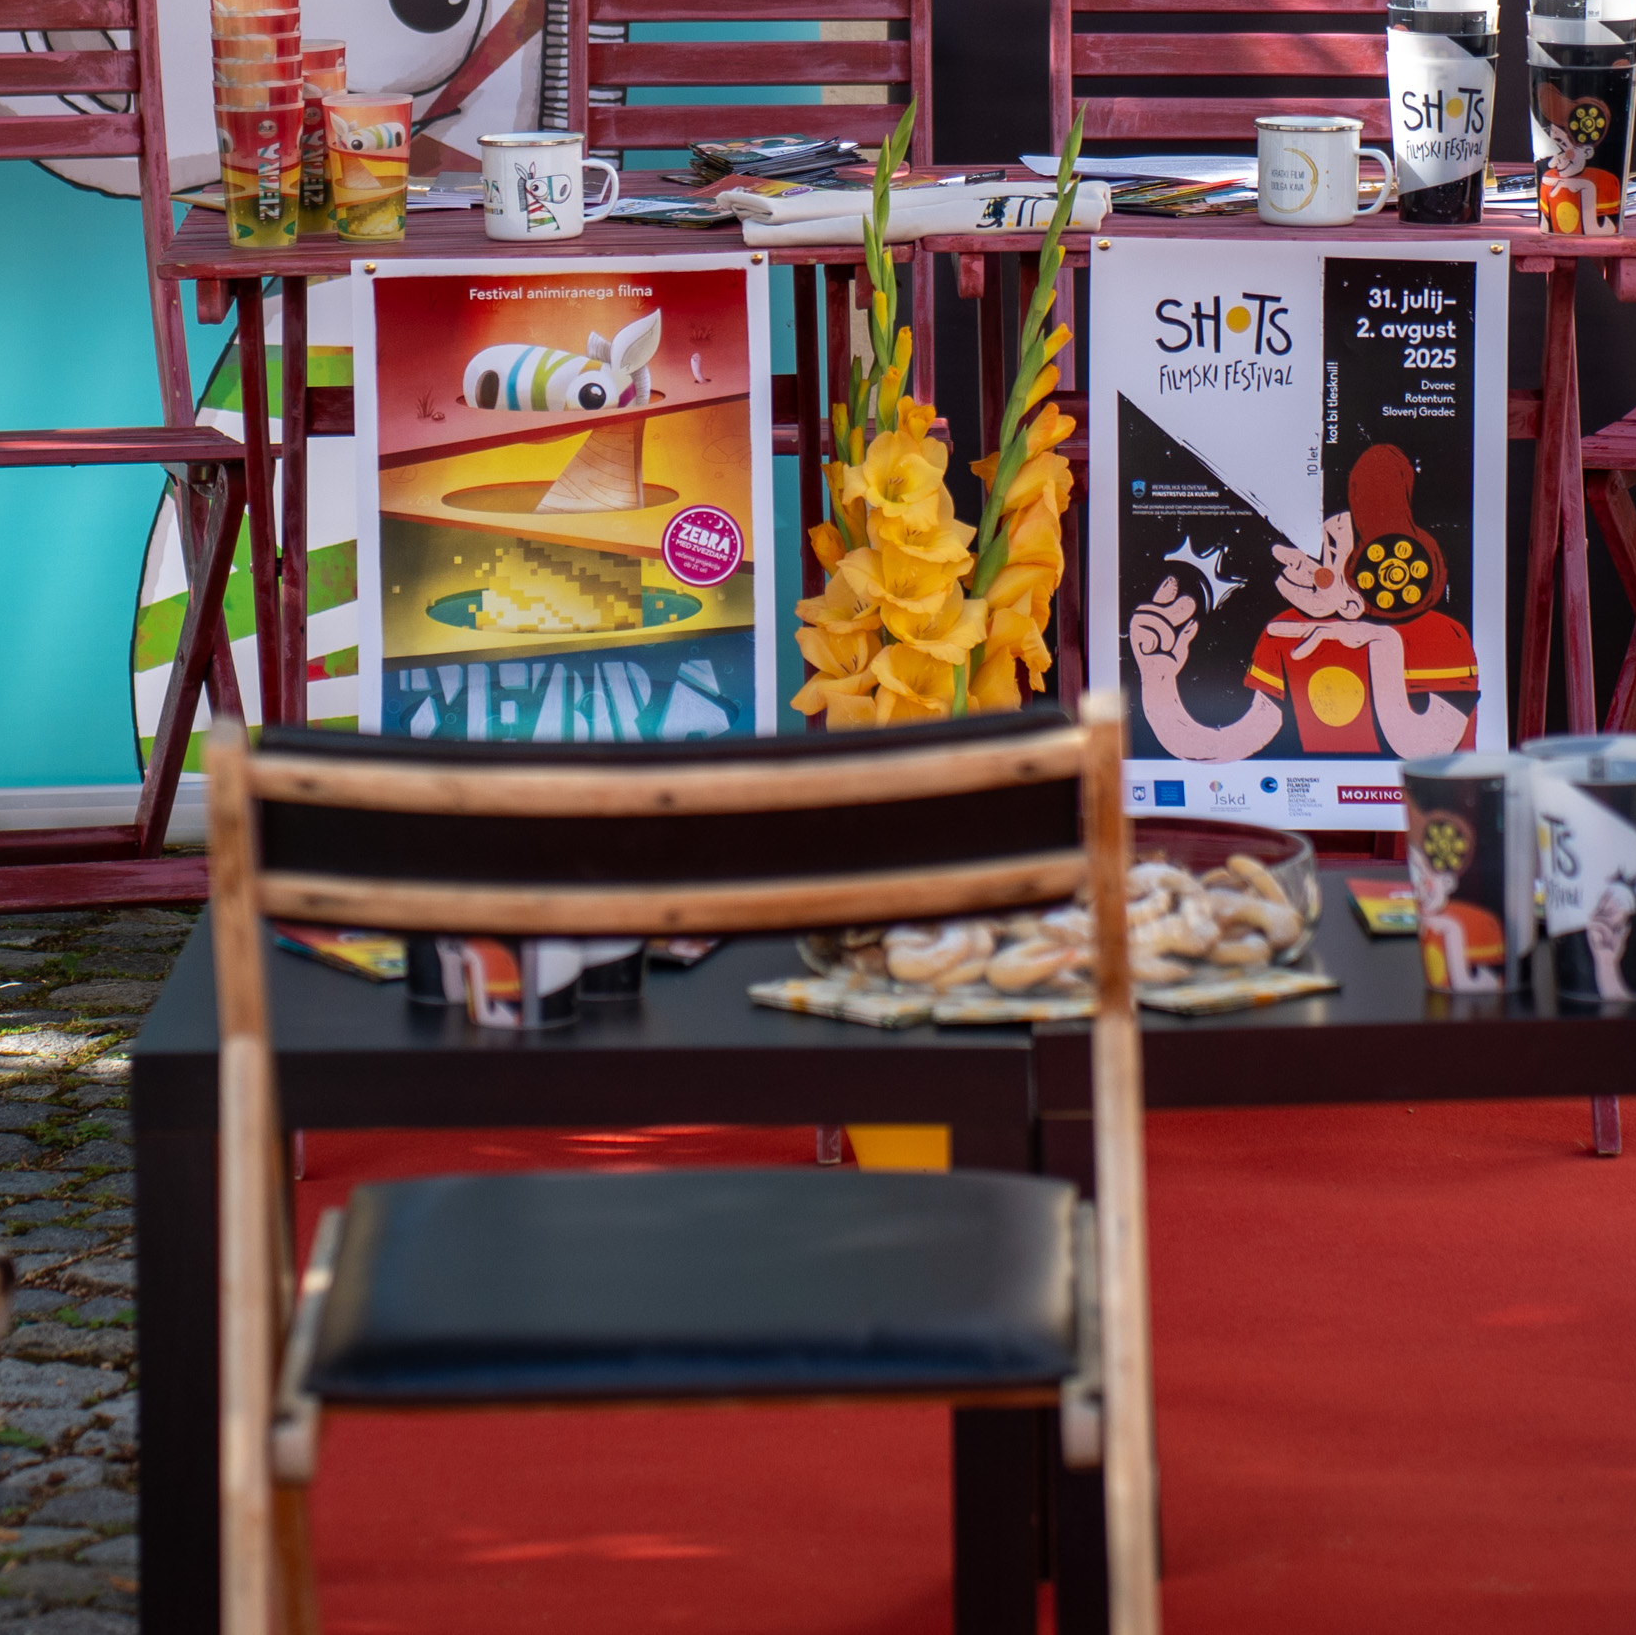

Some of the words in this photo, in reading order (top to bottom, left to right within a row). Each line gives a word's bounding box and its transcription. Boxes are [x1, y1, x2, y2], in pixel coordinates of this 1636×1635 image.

[1402, 87, 1484, 135] SHOTS
[1406, 139, 1441, 162] FILMSKI
[257, 142, 282, 221] ZEBRA
[1290, 169, 1305, 179] FILMI
[1290, 182, 1305, 191] KAVA
[469, 287, 523, 301] Festival
[526, 285, 614, 300] animiranega
[617, 284, 653, 298] filma
[1368, 288, 1397, 309] 31.
[1155, 292, 1293, 356] SHOTS
[1356, 317, 1376, 338] 2.
[1380, 320, 1457, 345] avgust
[1403, 348, 1457, 369] 2025
[1160, 363, 1218, 394] FILMSKI
[1421, 380, 1456, 390] Dvorec
[1326, 410, 1338, 422] bi
[1382, 406, 1417, 418] Slovenj
[1418, 406, 1456, 417] Gradec
[1326, 424, 1338, 444] kot
[1307, 446, 1318, 461] let
[1307, 464, 1318, 476] 10
[675, 538, 692, 550] MED
[678, 523, 731, 554] ZEBRA
[1341, 790, 1403, 800] MOJKINO
